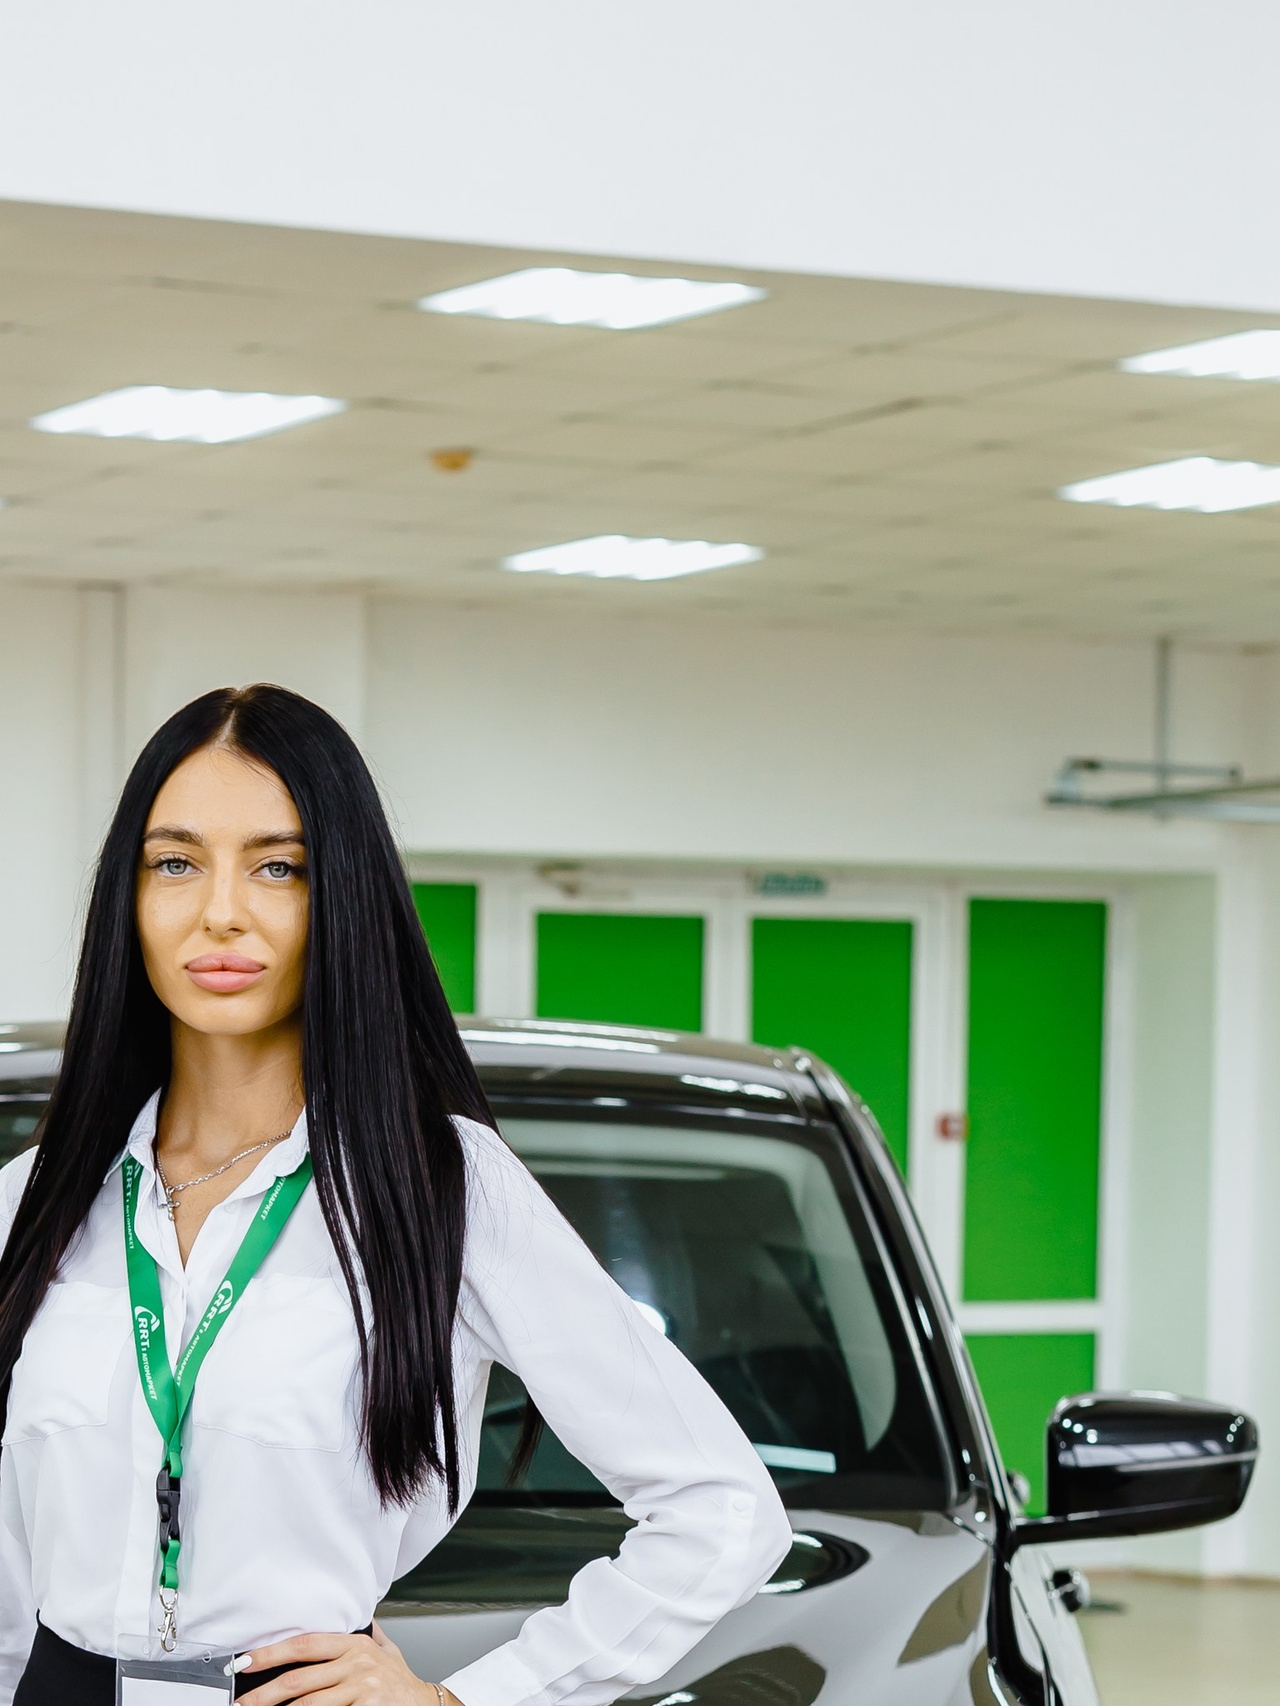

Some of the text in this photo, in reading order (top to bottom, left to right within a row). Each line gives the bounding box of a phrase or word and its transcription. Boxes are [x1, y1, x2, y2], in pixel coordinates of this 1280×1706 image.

[126, 1165, 134, 1199] RRT
[260, 1176, 287, 1221] ТОМАРКЕТ
[138, 1317, 158, 1400] RRT АВТОМАРКЕТ
[176, 1293, 225, 1387] RRT АВТОМАРКЕТ
